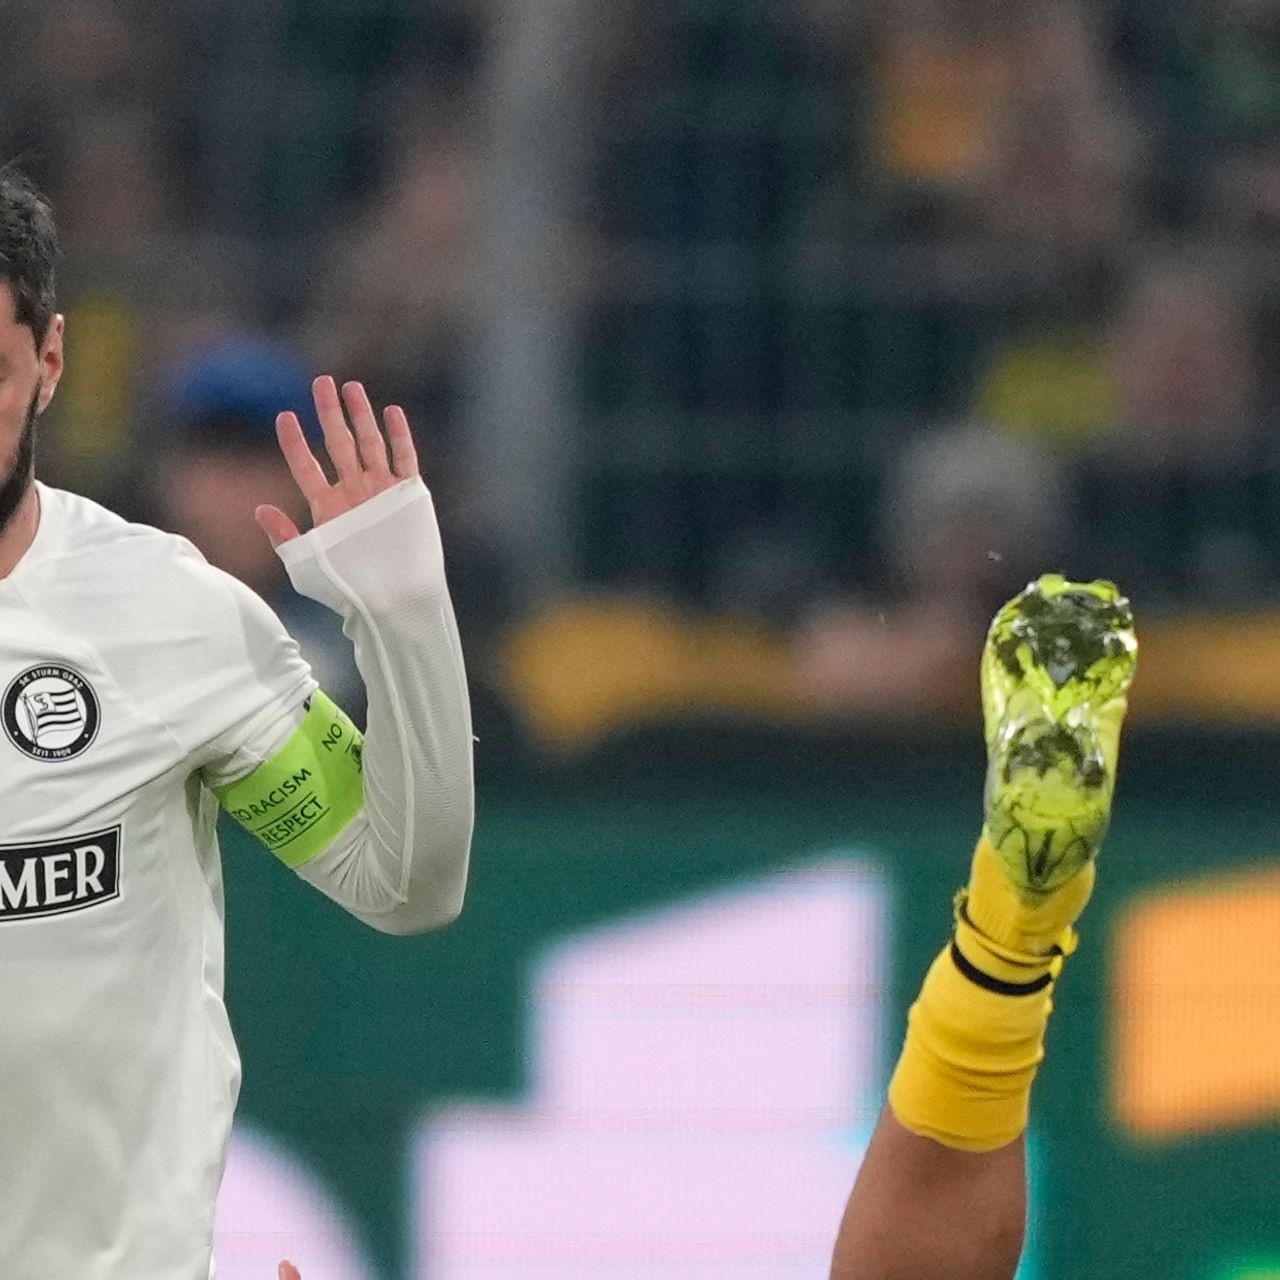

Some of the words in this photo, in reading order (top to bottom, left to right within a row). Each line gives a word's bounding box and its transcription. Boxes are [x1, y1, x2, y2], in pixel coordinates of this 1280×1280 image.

[31, 668, 59, 679] STURM
[322, 723, 342, 752] NO
[249, 767, 312, 816] RACISM
[261, 796, 323, 845] RESPECT
